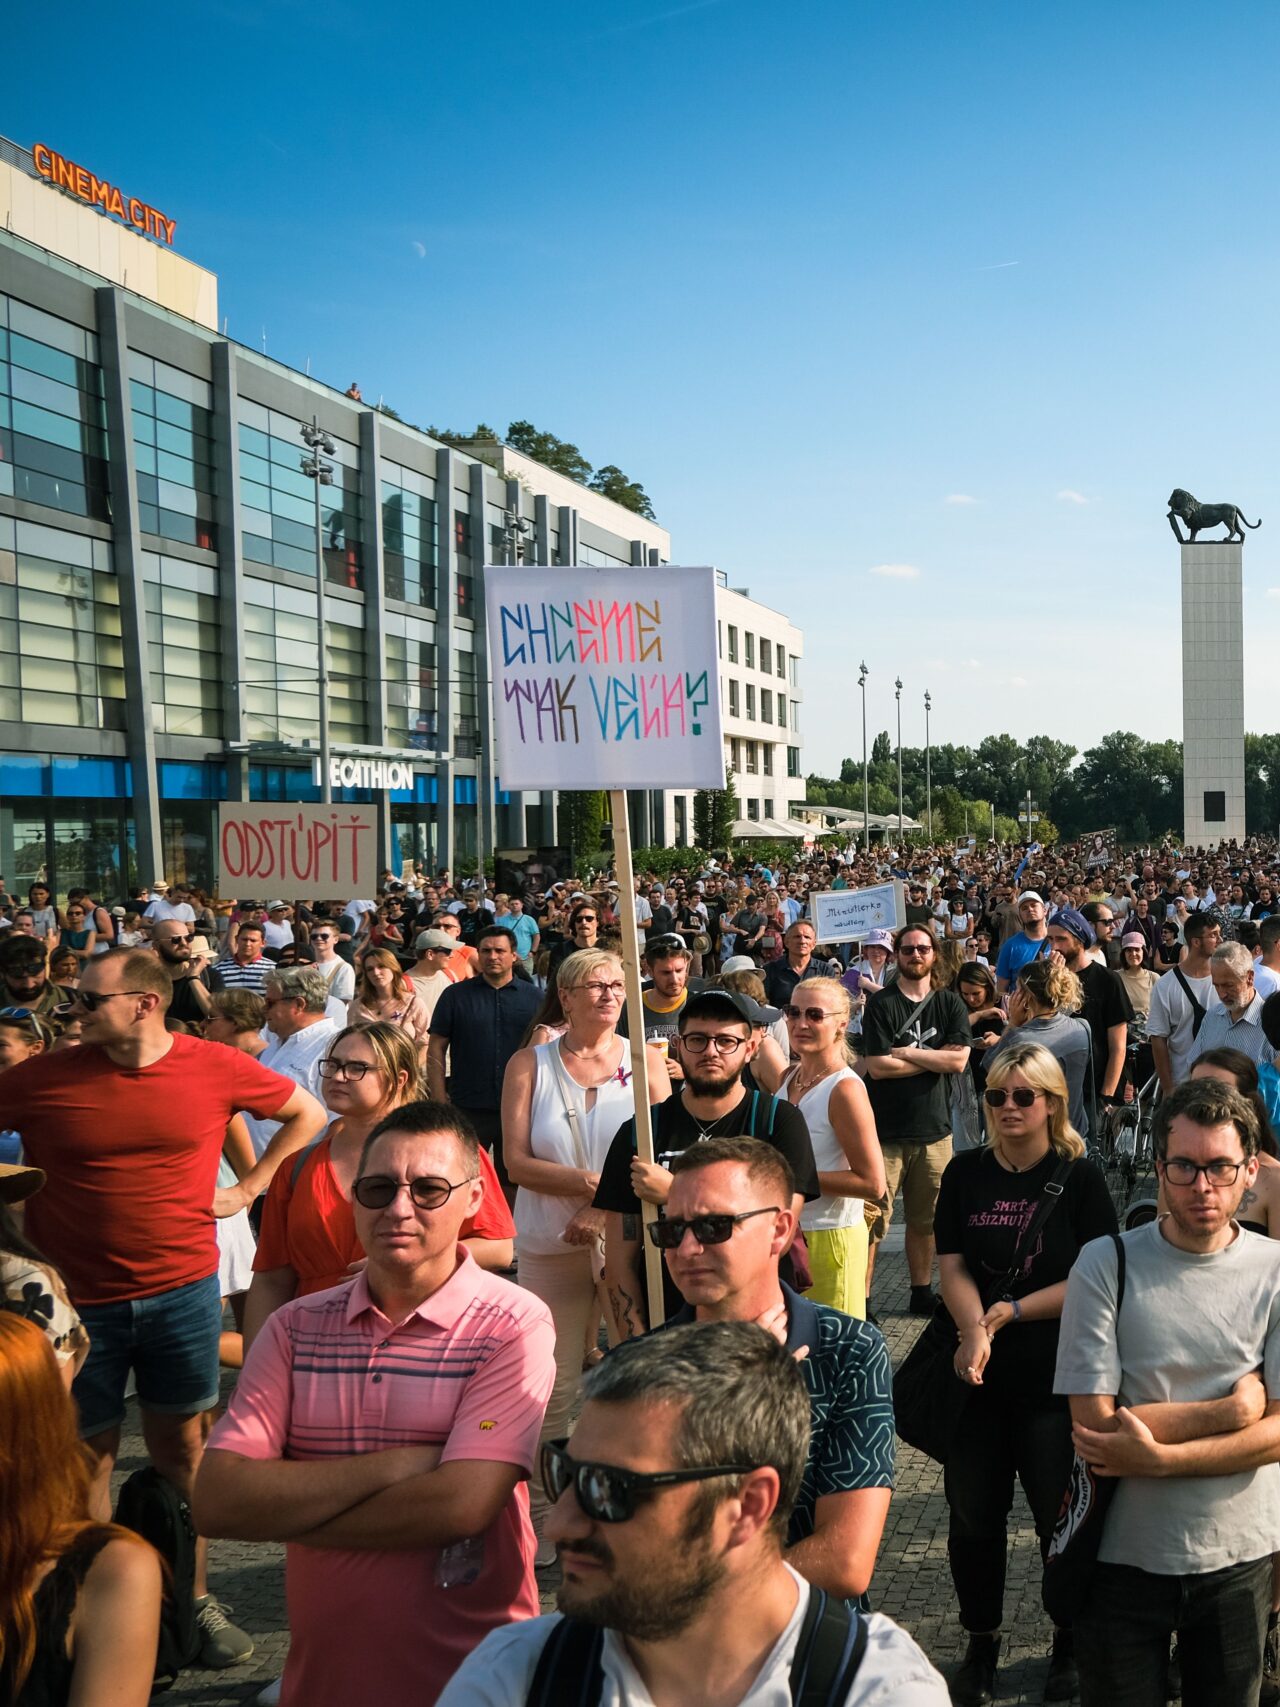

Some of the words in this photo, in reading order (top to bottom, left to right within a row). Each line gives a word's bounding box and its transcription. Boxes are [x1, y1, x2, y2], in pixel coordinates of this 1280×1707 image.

[33, 143, 127, 219] CINEMA
[129, 198, 176, 245] CITY
[500, 599, 662, 666] CHCEME
[504, 674, 579, 743] TAK
